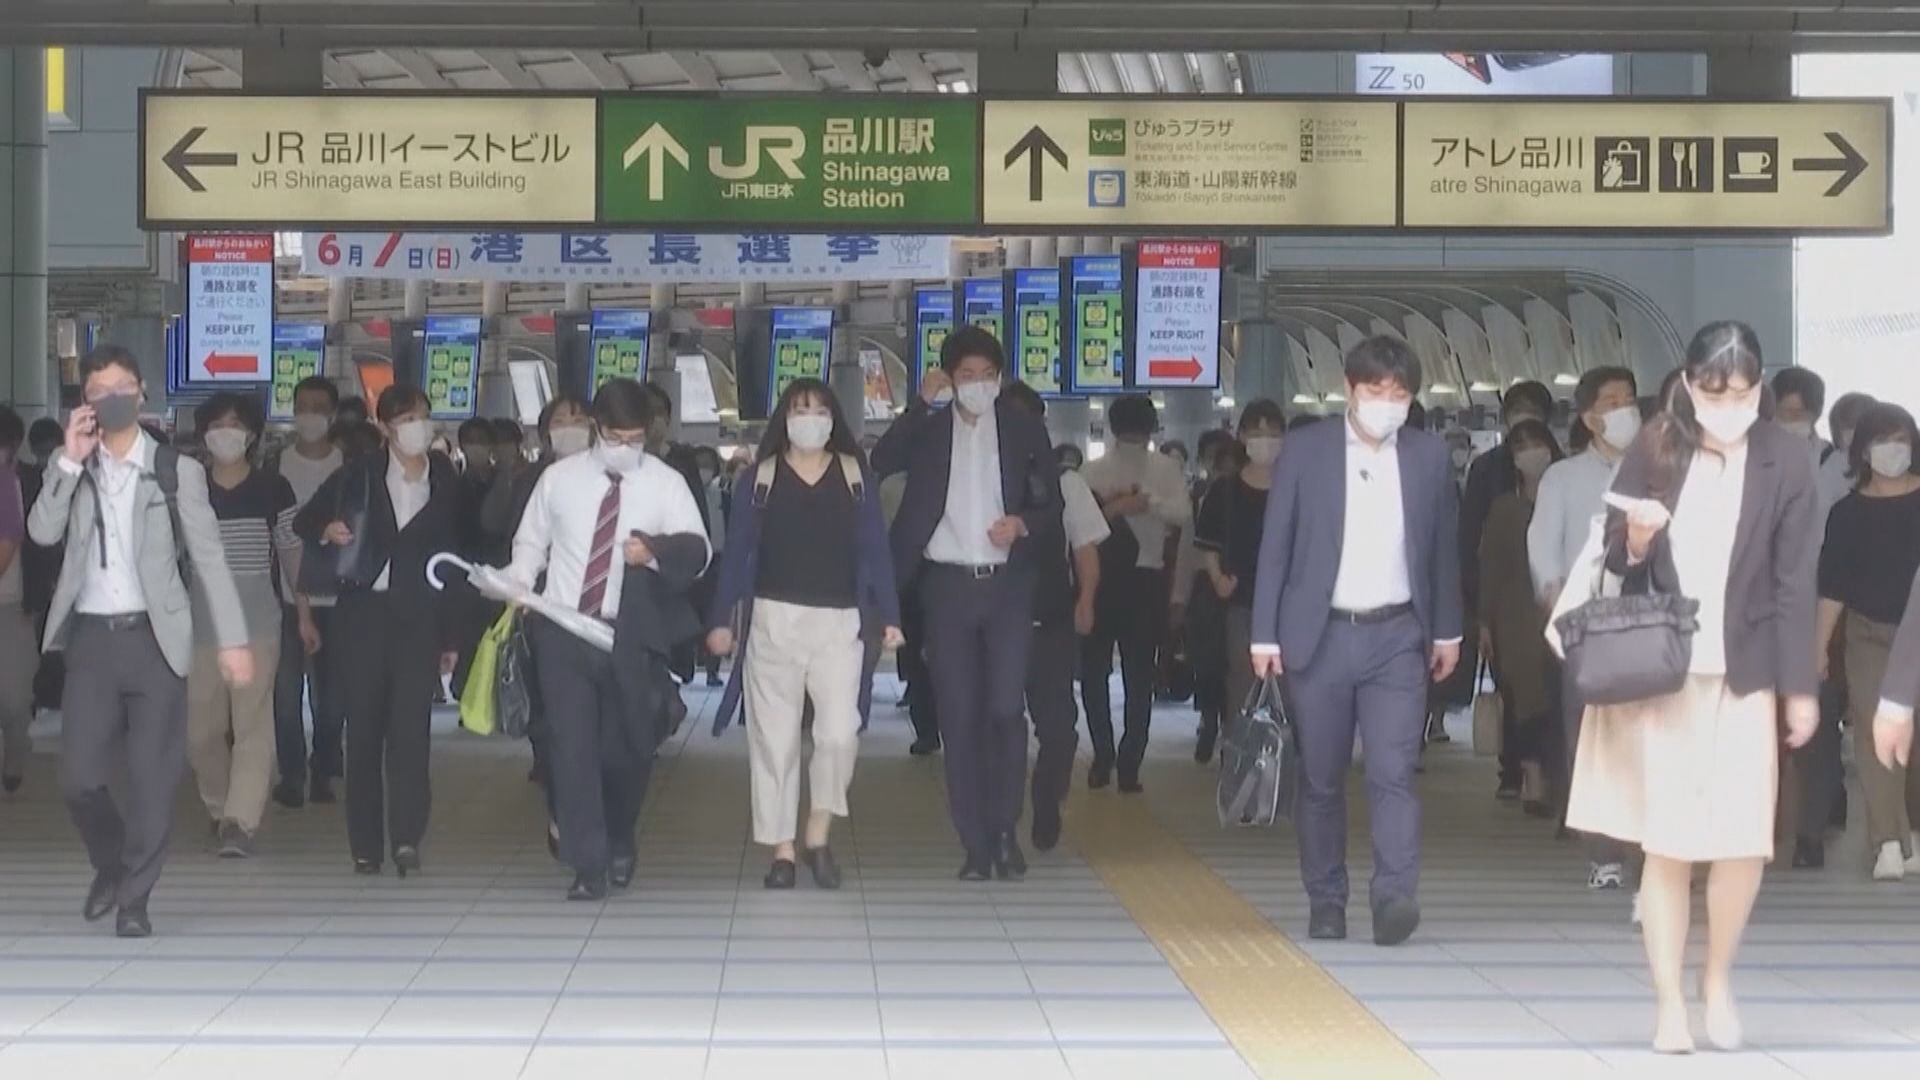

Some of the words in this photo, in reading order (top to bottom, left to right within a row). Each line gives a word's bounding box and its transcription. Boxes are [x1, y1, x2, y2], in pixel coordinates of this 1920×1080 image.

[1402, 73, 1425, 91] 50
[822, 117, 936, 155] 品川駅
[1133, 118, 1234, 137] びゅうプラザ
[251, 131, 304, 165] JR
[321, 131, 571, 165] 品川イーストビル
[708, 125, 806, 179] JR
[1431, 136, 1584, 170] アトレ品川
[251, 171, 278, 189] JR
[284, 171, 393, 193] Shinagawa
[399, 171, 442, 189] East
[449, 171, 526, 193] Building
[822, 160, 951, 186] Shinagawa
[1134, 170, 1297, 189] 東海道・山陽新幹線
[721, 182, 795, 199] JR東日本
[1430, 176, 1468, 193] atre
[1474, 175, 1582, 197] Shinagawa
[822, 187, 905, 208] Station
[214, 251, 247, 260] NOTICE
[1163, 257, 1196, 266] NOTICE
[205, 324, 231, 335] KEEP
[232, 324, 256, 335] LEFT
[1150, 330, 1175, 340] KEEP
[1176, 330, 1204, 340] RIGHT
